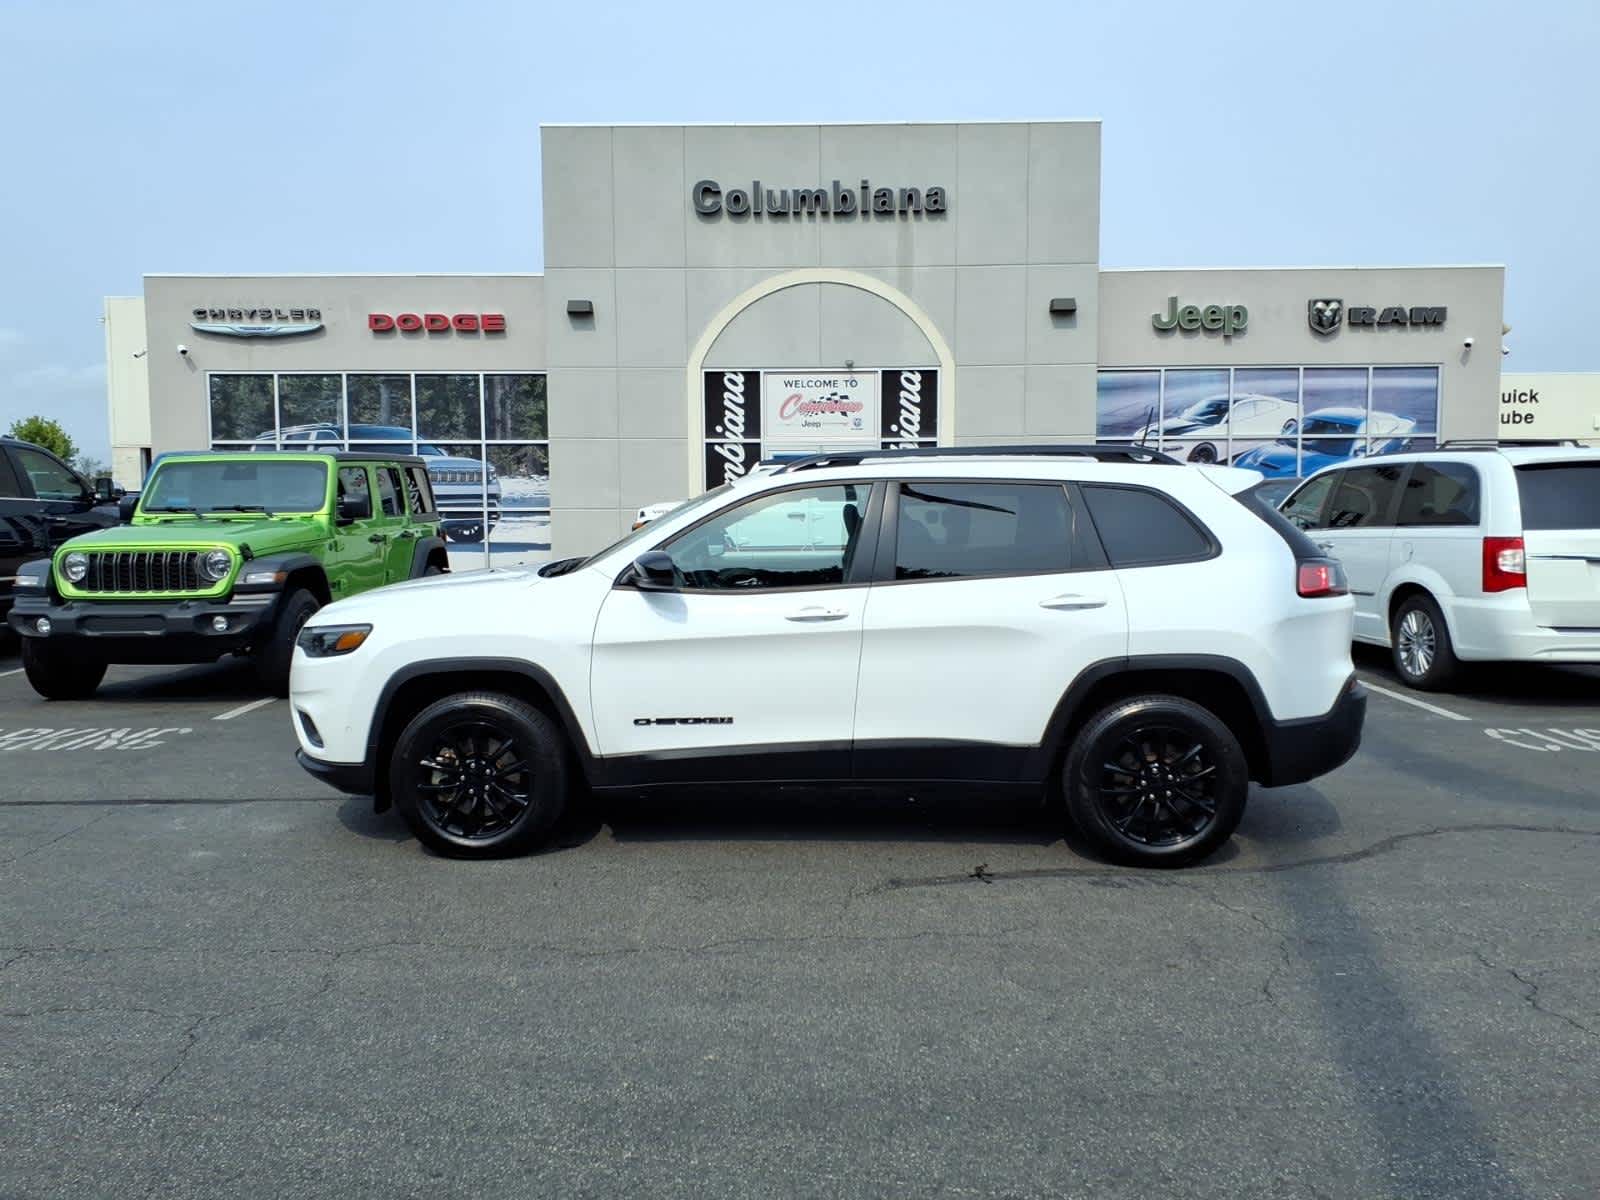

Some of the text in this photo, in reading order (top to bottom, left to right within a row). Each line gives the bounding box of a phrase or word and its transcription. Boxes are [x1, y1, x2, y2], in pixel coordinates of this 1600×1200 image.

[692, 179, 947, 215] Columbiana
[193, 308, 322, 321] CHRYSLER
[368, 313, 506, 333] DODGE
[1152, 296, 1248, 336] Jeep
[1347, 306, 1447, 325] RAM
[783, 378, 858, 389] WELCOME TO
[1501, 388, 1540, 404] uick
[1500, 410, 1535, 424] ube
